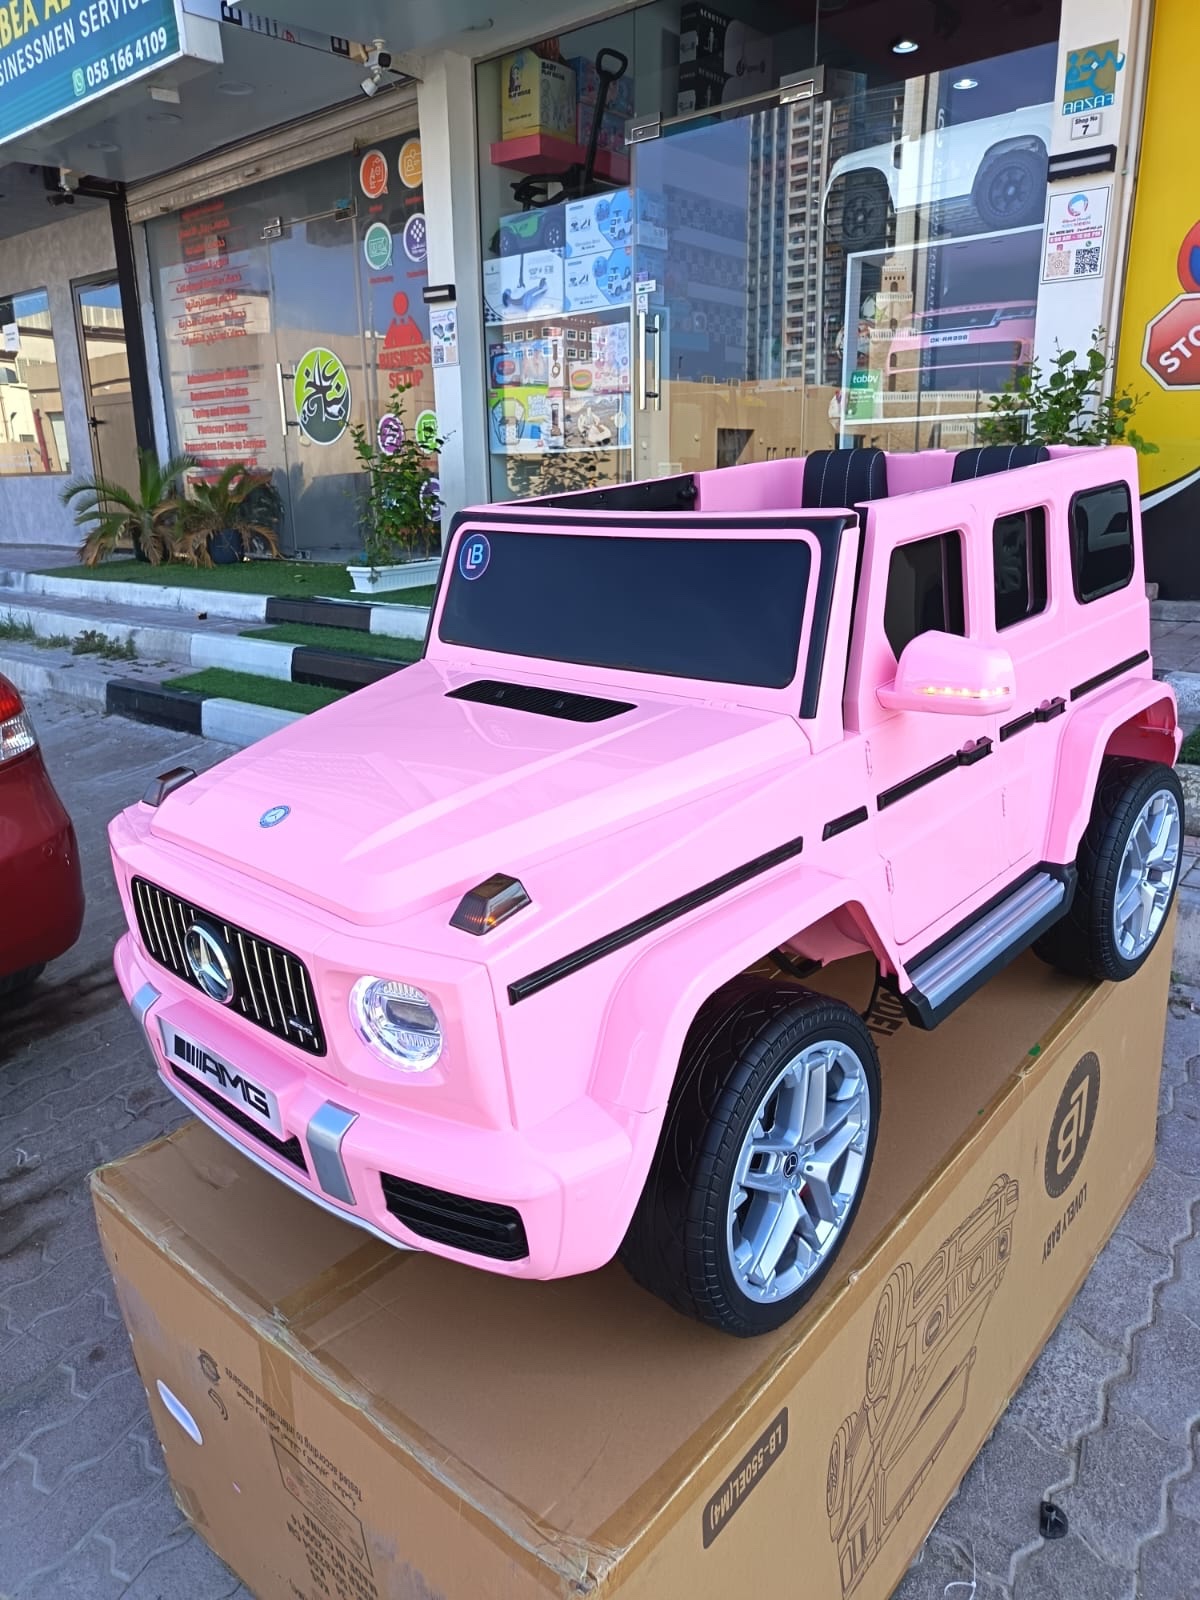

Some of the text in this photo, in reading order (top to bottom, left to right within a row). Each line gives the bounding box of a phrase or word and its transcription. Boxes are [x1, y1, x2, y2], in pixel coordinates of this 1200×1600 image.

[0, 0, 39, 49] BEA
[86, 27, 167, 87] 058 166 4109
[1082, 124, 1090, 135] 7
[379, 347, 431, 370] BUSINESS
[1159, 324, 1200, 374] STO
[389, 370, 423, 389] SETUP
[852, 373, 879, 384] tabby
[202, 1051, 271, 1119] AMG
[1041, 1181, 1088, 1265] LOVELY BABY
[255, 1394, 296, 1434] international
[304, 1436, 338, 1476] according
[339, 1471, 363, 1502] Tested
[303, 1512, 333, 1551] CHINA
